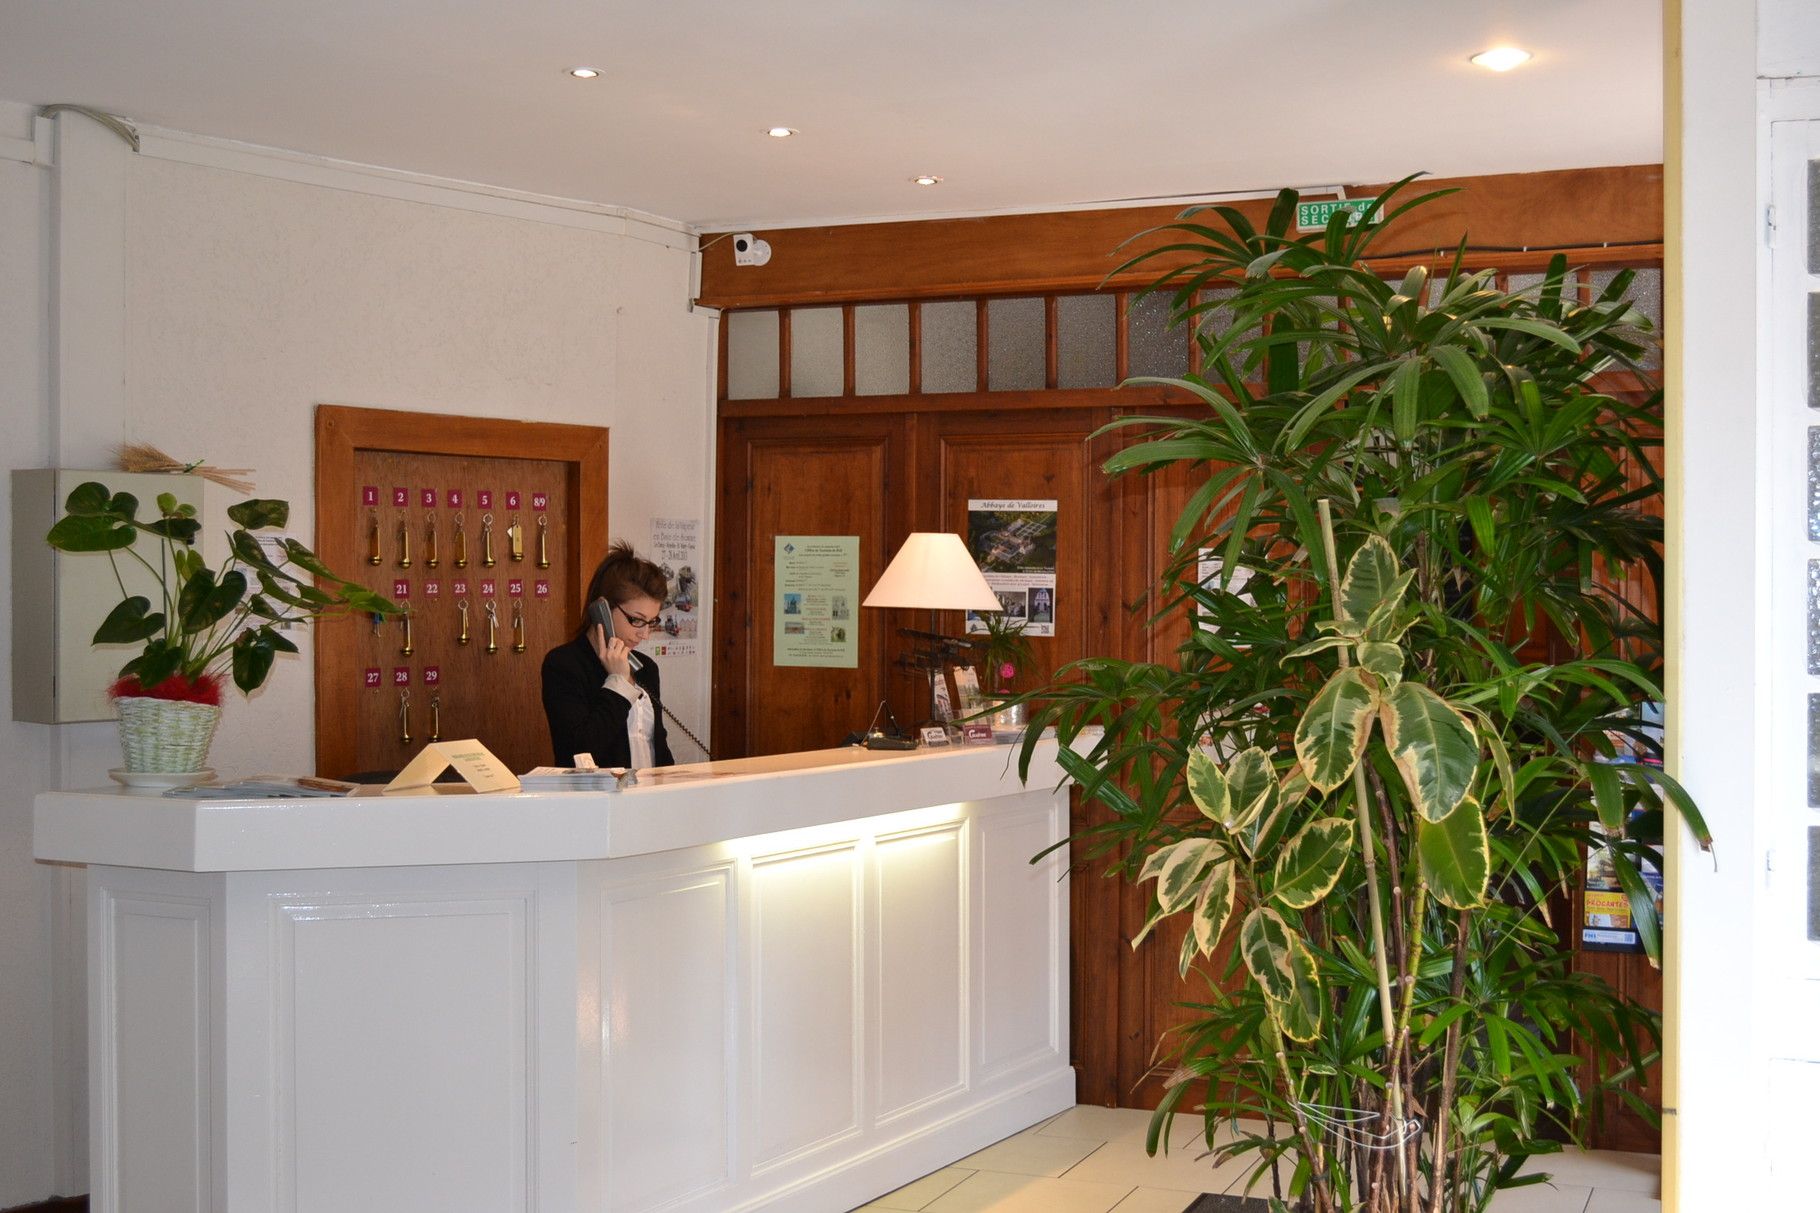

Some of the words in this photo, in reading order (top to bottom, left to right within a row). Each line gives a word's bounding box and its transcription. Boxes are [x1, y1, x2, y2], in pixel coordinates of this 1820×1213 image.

[368, 491, 373, 501] 1
[397, 492, 404, 502] 2
[426, 493, 432, 503] 3
[452, 494, 458, 504] 4
[482, 495, 488, 505] 5
[509, 496, 517, 506] 6
[981, 502, 1006, 510] Abbaye
[1007, 501, 1015, 509] de
[1017, 501, 1045, 509] Valloires
[396, 584, 407, 594] 21
[426, 583, 438, 594] 22
[454, 583, 466, 594] 23
[482, 583, 494, 594] 24
[510, 583, 521, 593] 25
[536, 584, 548, 594] 26
[367, 672, 379, 683] 27
[396, 671, 408, 682] 28
[426, 670, 438, 681] 29
